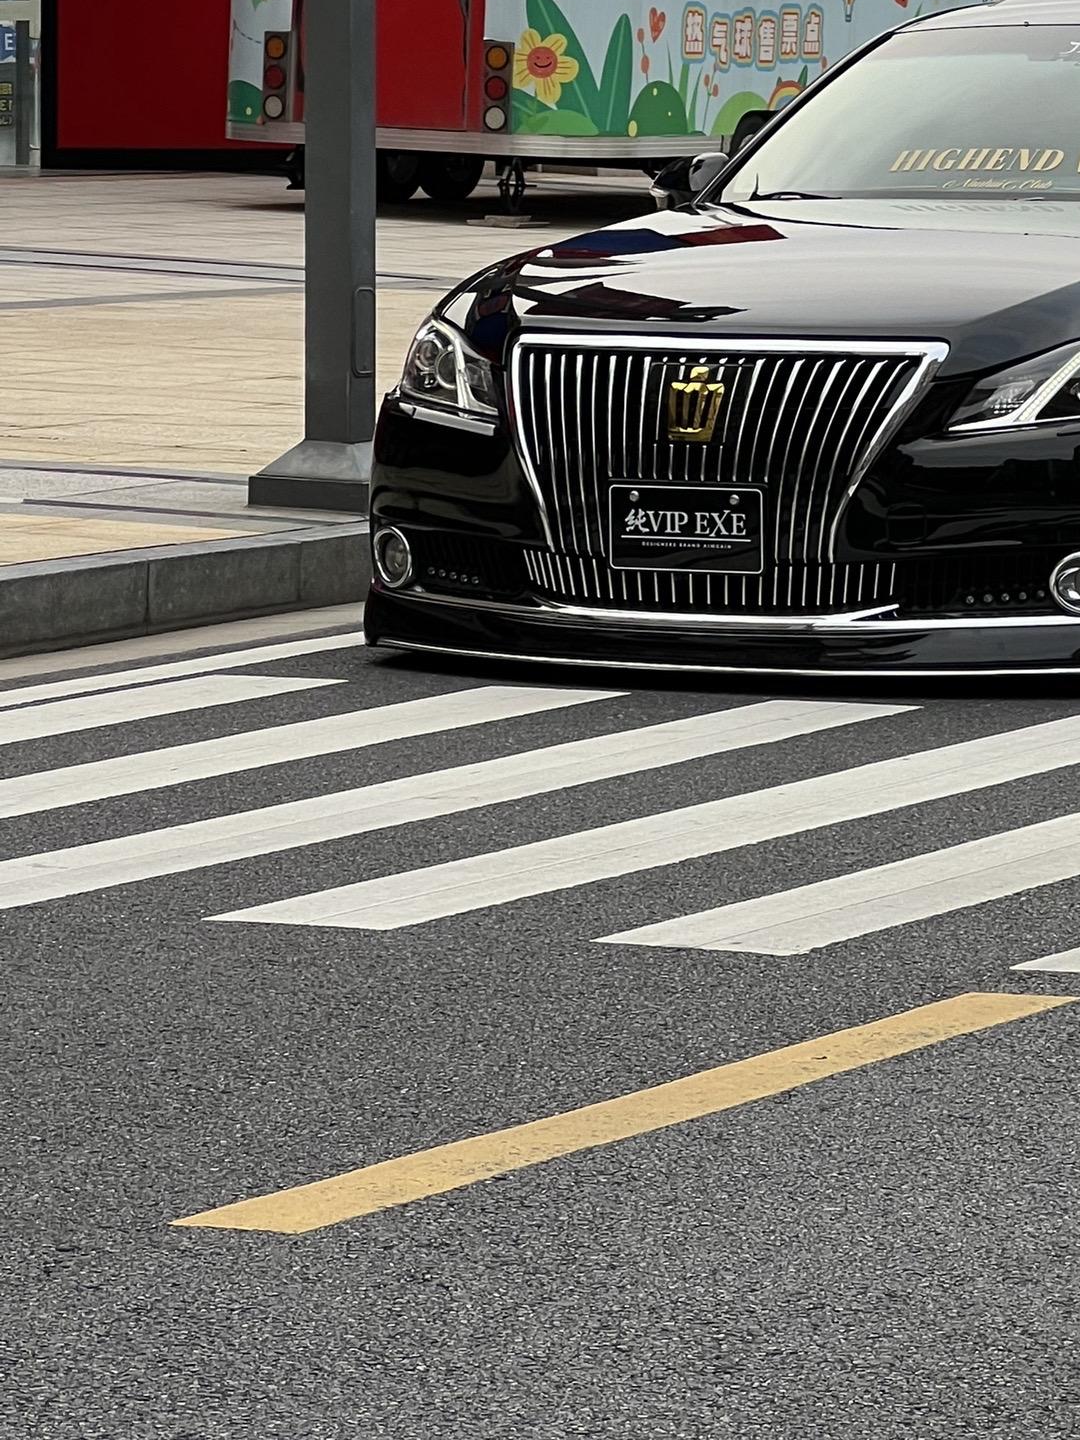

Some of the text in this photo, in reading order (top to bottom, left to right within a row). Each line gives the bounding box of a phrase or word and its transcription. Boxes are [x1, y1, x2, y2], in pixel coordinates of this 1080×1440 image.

[683, 9, 822, 65] 热气球售票点
[889, 148, 1065, 172] HIGHEND
[694, 510, 747, 537] EXE
